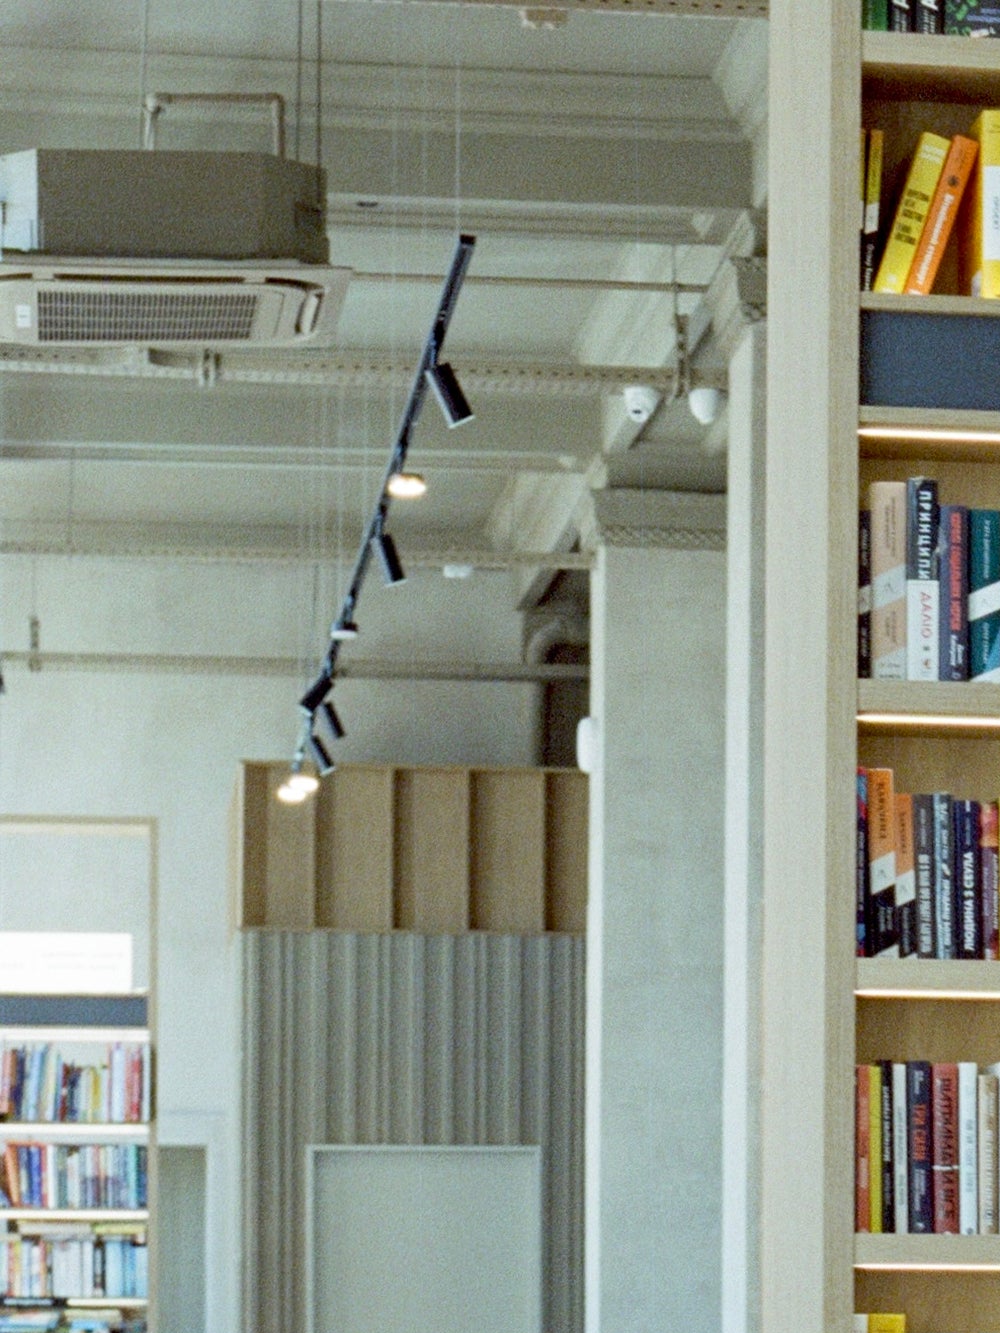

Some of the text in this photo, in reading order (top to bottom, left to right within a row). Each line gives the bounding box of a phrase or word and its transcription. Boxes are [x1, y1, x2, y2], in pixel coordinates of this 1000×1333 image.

[917, 491, 932, 580] ПРИНЦИПИ
[963, 852, 974, 888] СЕУЛА
[962, 900, 975, 951] ЛЮДИНА
[913, 1103, 926, 1125] ТРИ
